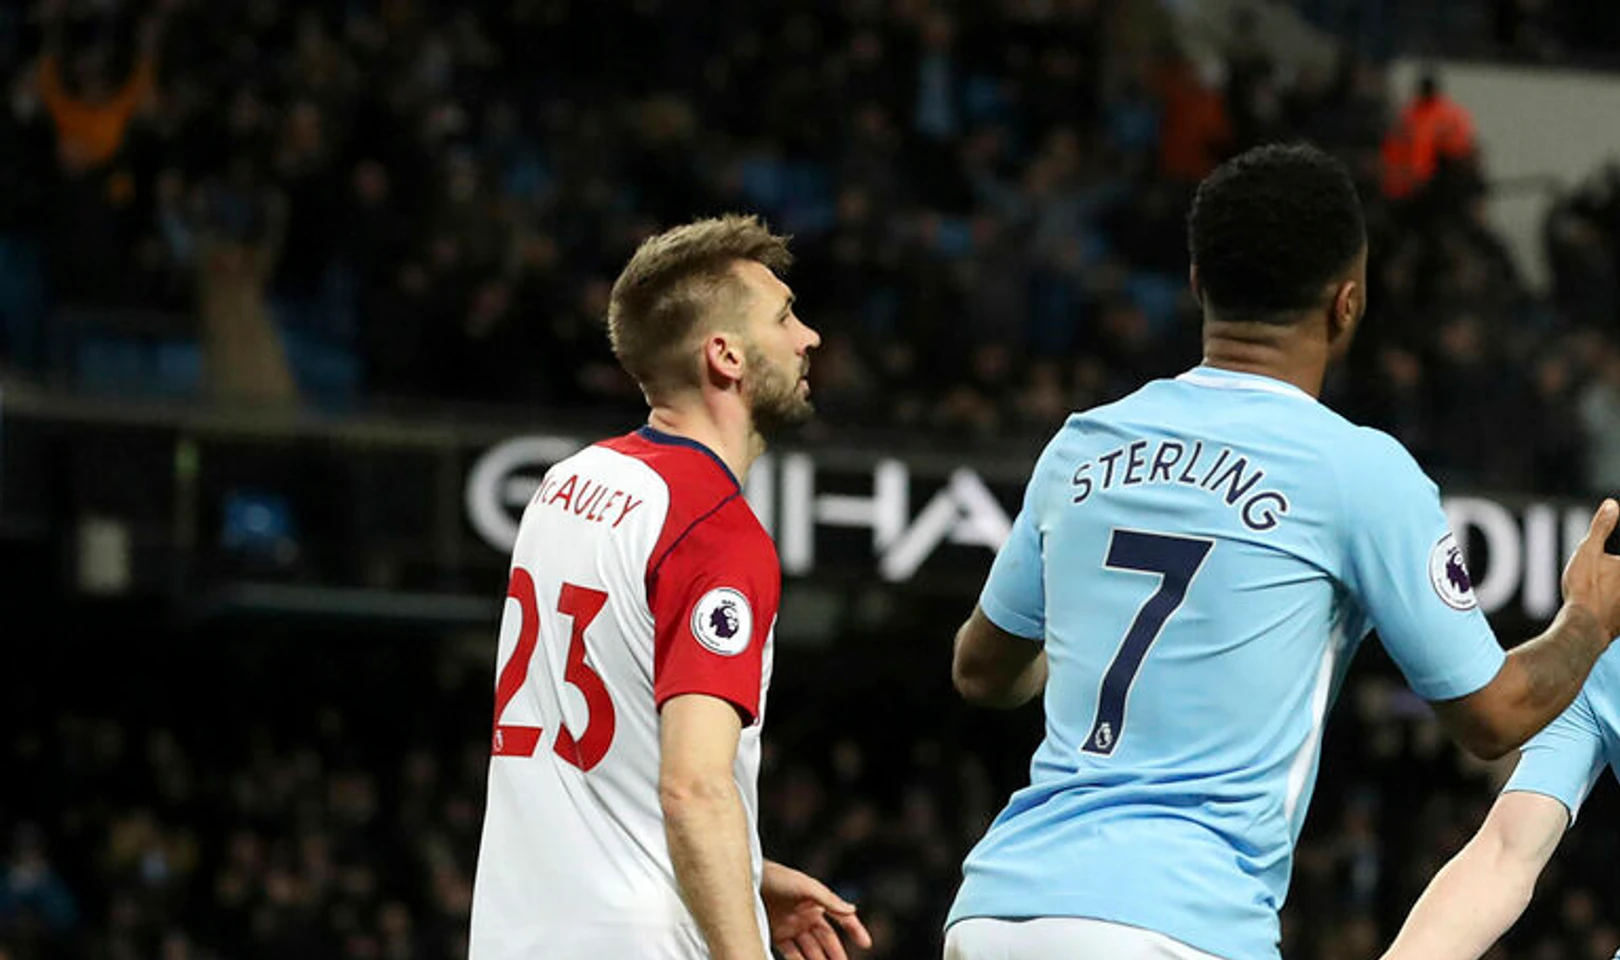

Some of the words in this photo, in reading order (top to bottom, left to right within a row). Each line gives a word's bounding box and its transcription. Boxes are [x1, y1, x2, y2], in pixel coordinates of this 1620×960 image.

[1072, 440, 1289, 531] STERLING
[491, 566, 616, 774] 23
[1080, 528, 1216, 758] 7
